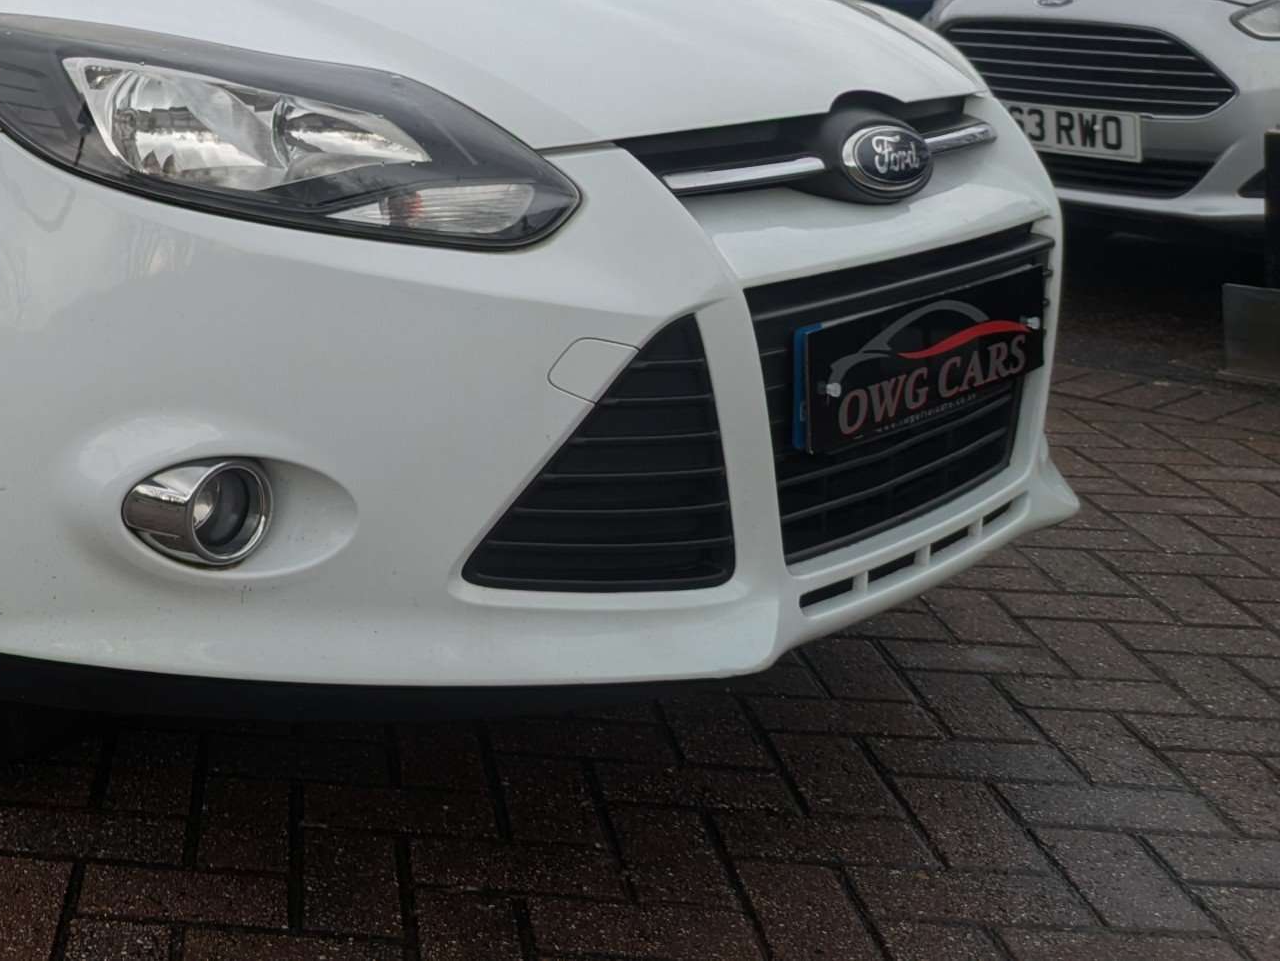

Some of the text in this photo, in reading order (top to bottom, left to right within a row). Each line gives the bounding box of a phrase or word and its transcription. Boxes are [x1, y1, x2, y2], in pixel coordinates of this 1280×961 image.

[1056, 111, 1122, 151] RWO
[871, 134, 920, 174] Ford
[838, 366, 928, 435] OWG
[938, 335, 1027, 400] CARS
